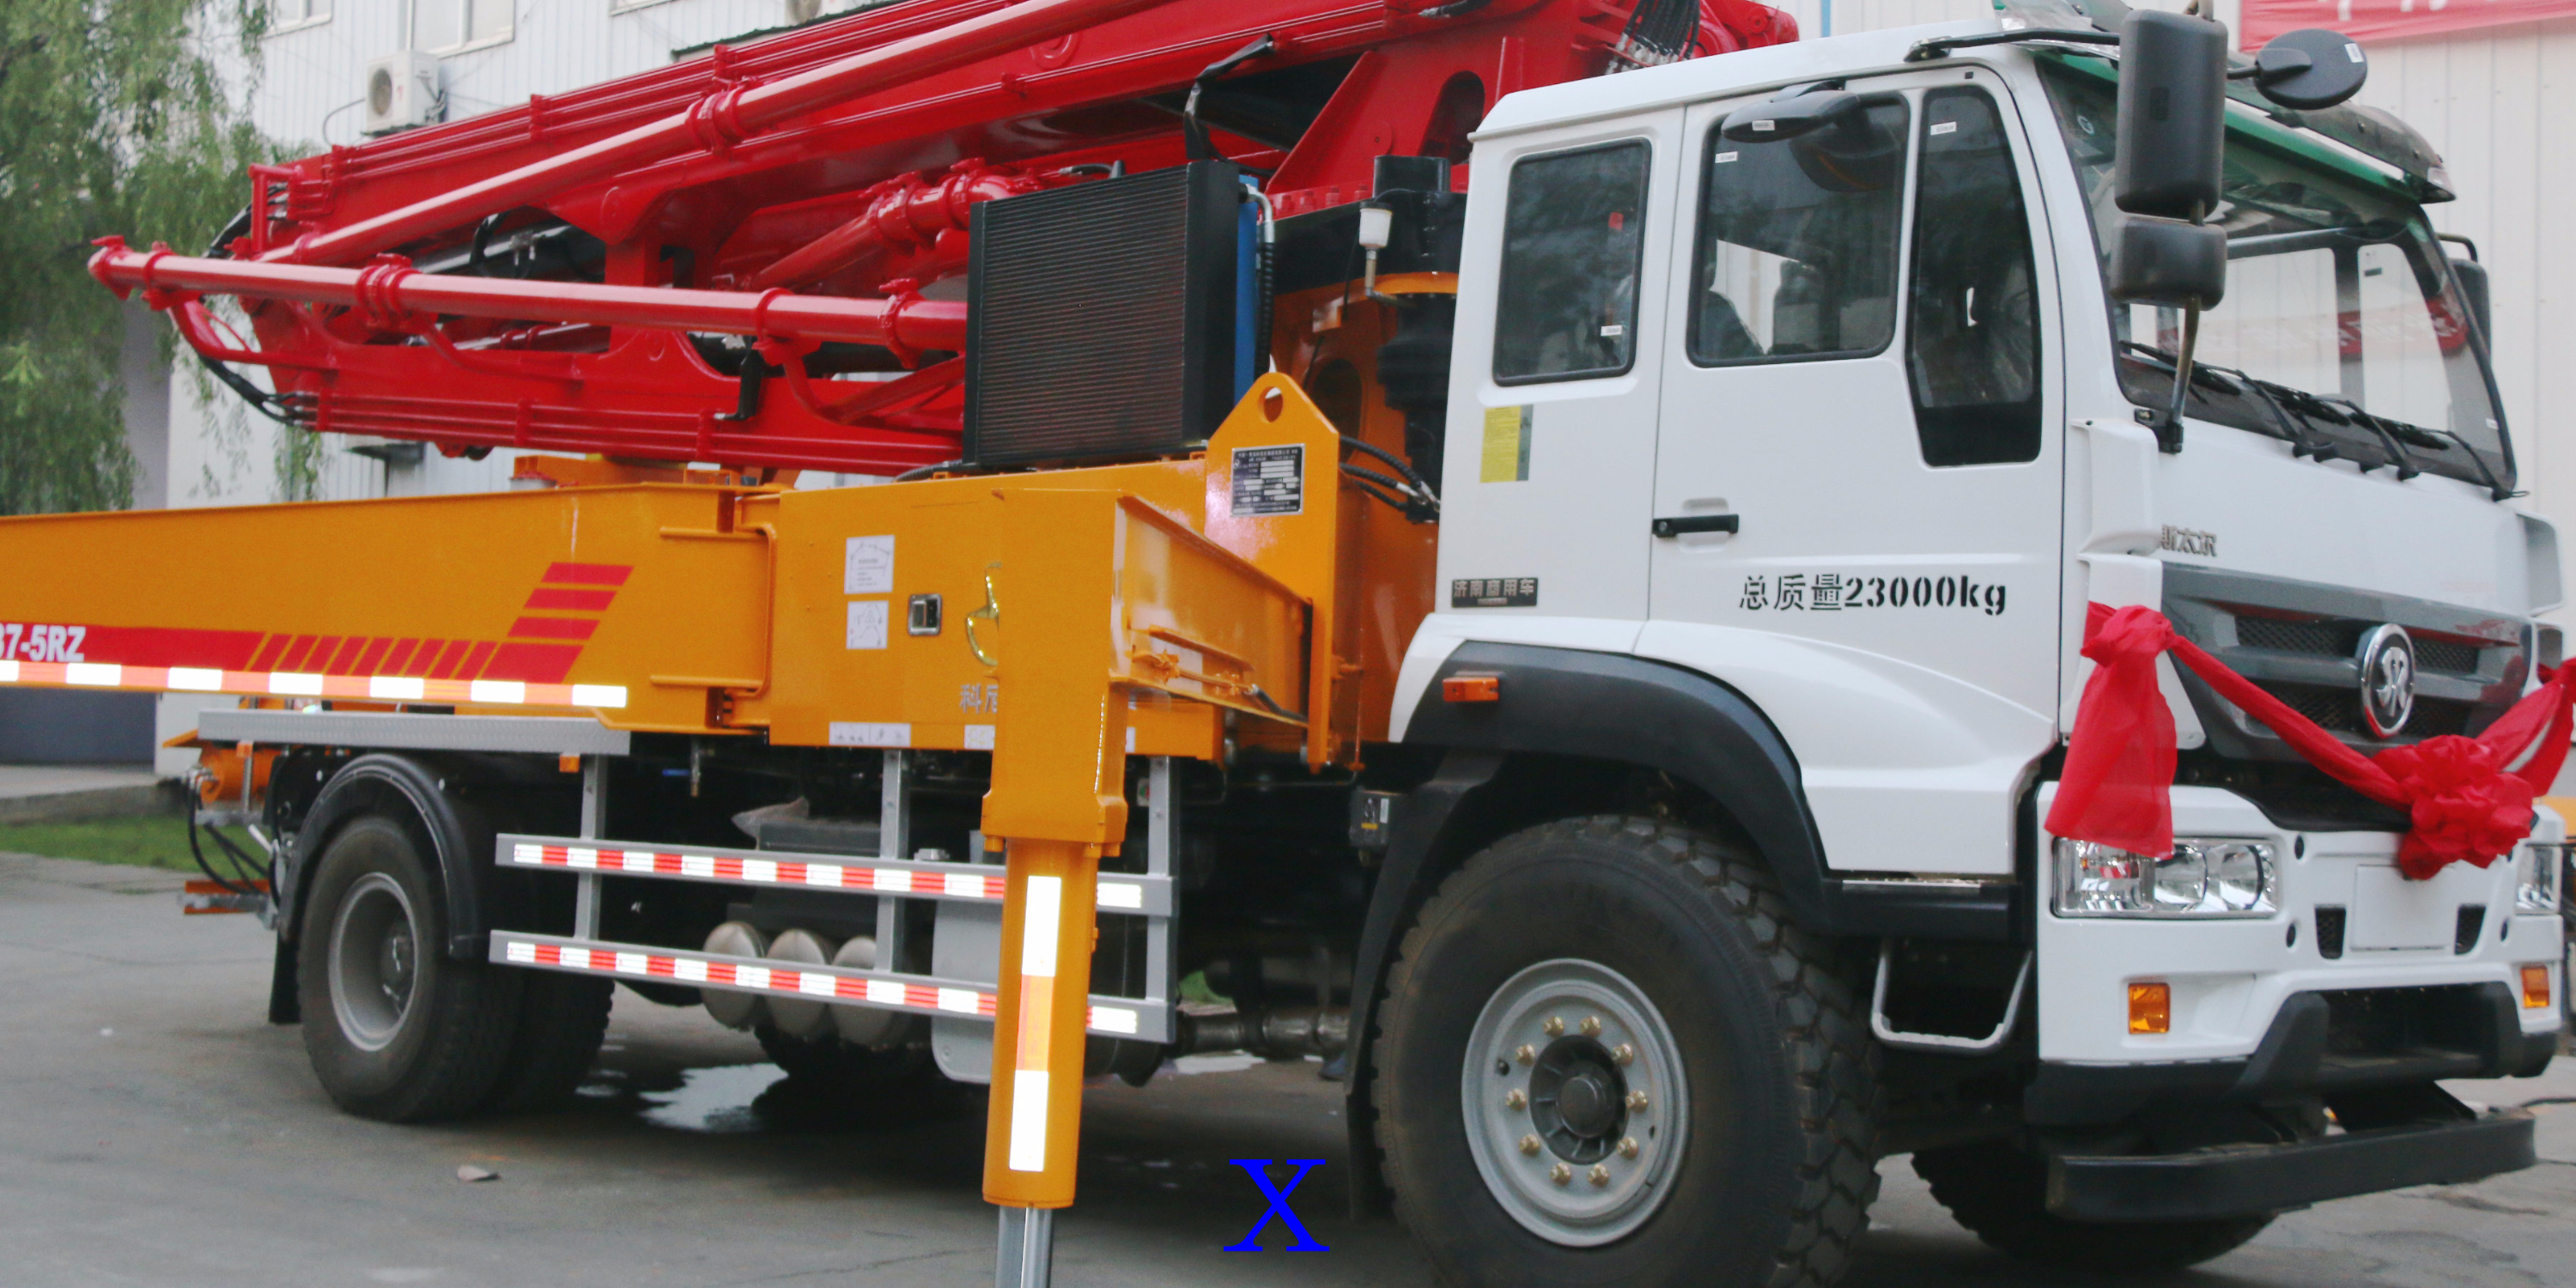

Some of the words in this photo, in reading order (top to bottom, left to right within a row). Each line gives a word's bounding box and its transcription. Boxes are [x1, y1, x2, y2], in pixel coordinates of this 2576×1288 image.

[1454, 578, 1536, 598] 济南商用车
[1739, 573, 2007, 617] 总质量23000kg
[0, 623, 86, 663] 7-5RZ
